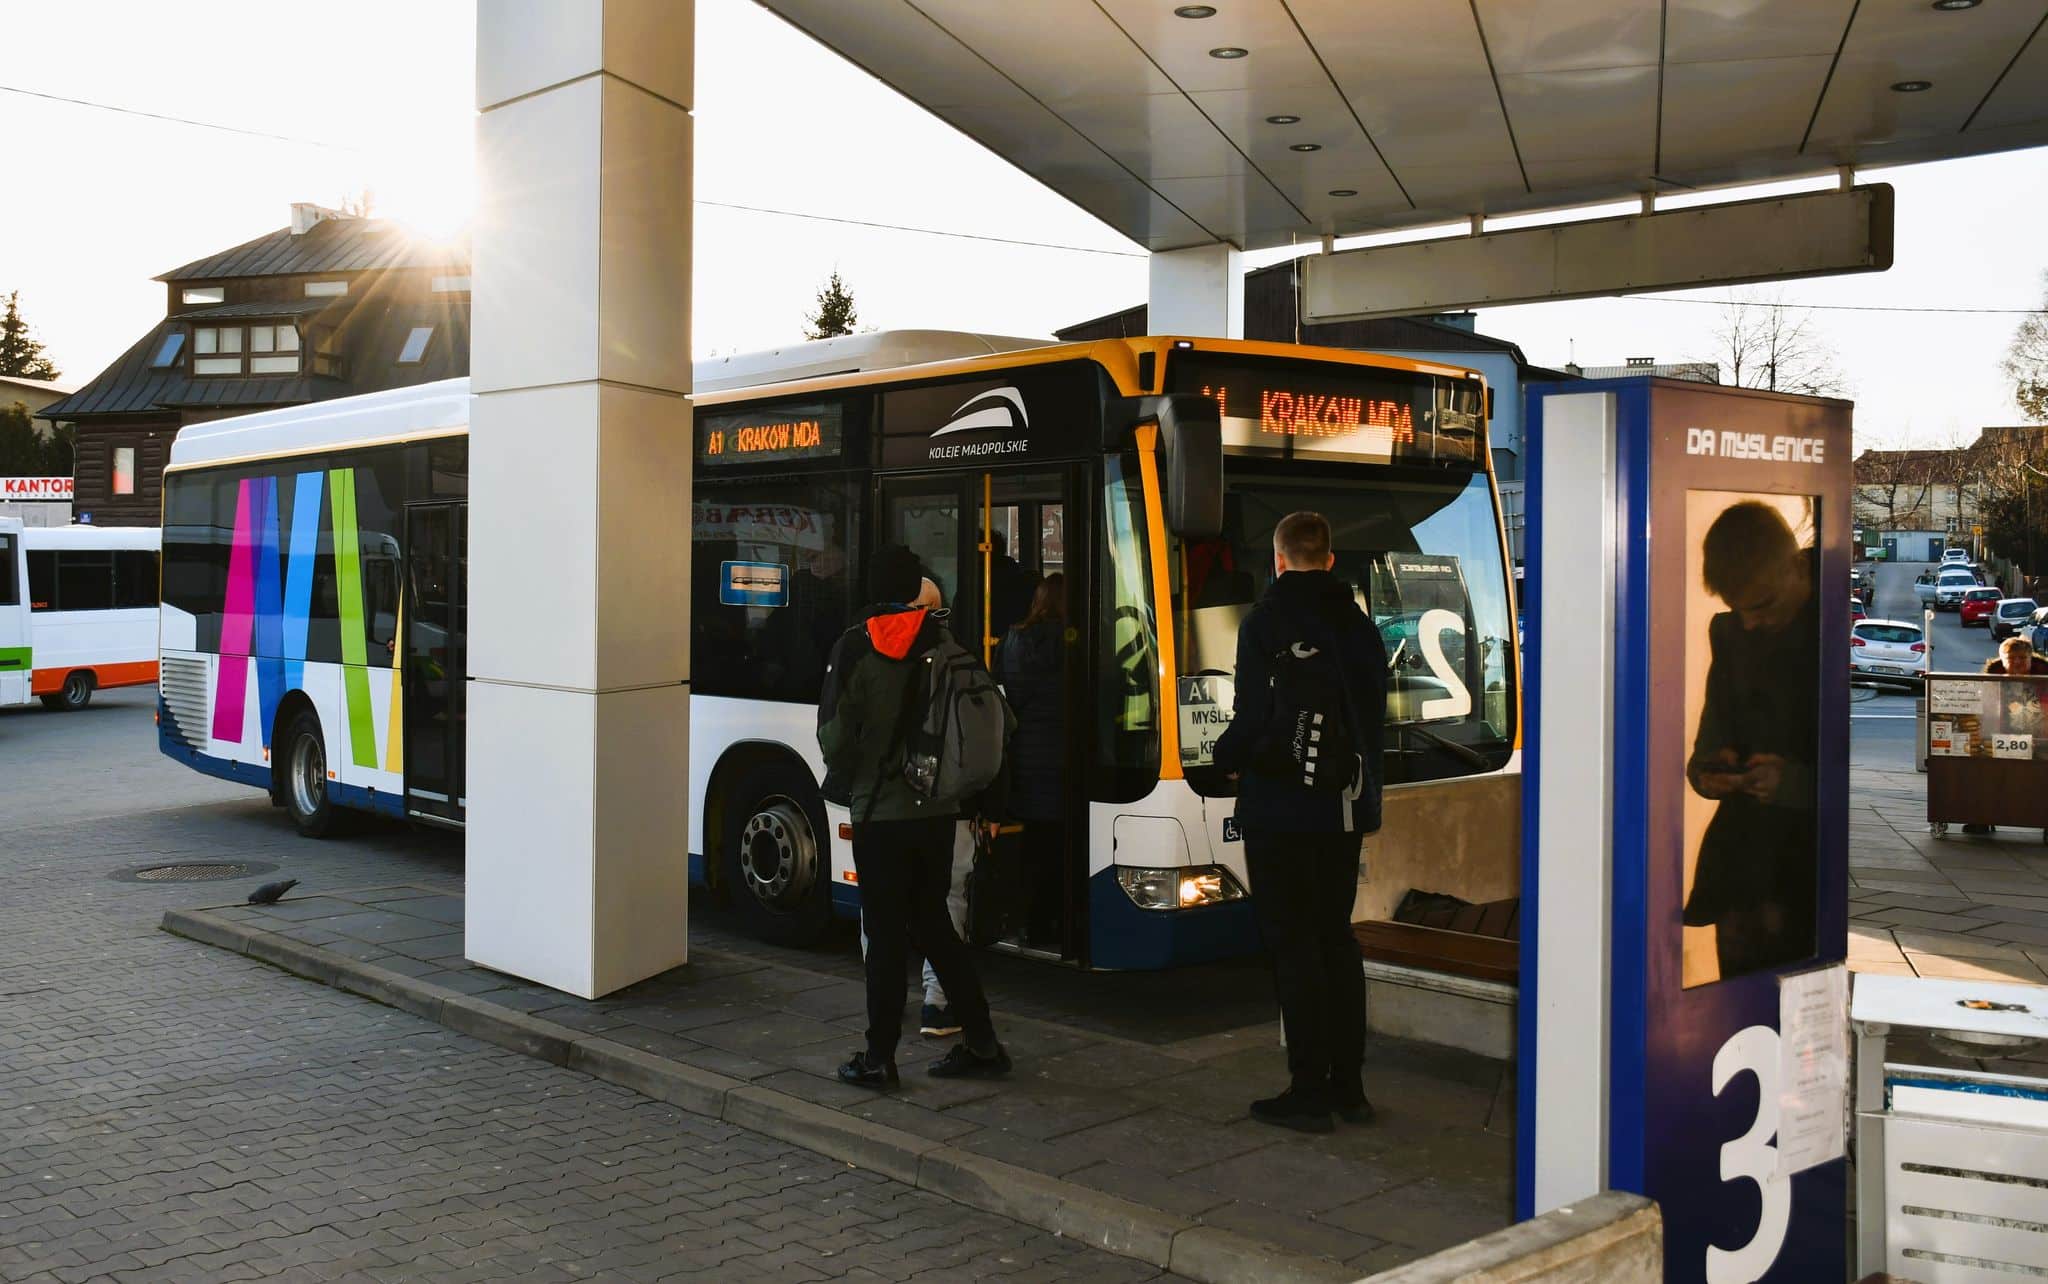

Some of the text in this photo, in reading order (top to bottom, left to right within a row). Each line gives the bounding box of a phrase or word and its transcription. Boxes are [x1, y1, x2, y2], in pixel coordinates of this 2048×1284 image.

[1200, 385, 1414, 443] 1 KRAKÓW MDA
[708, 421, 820, 454] A1 KRAKÓW MDA
[1686, 428, 1825, 464] DA MYSLENICE
[928, 440, 1029, 459] KOLEJE MAŁOPOLSKIE
[5, 479, 73, 492] KANTOR
[1188, 681, 1210, 701] A1
[1192, 706, 1232, 725] MYŚLE
[1996, 740, 2028, 751] 2,80
[1706, 1025, 1791, 1284] 3
